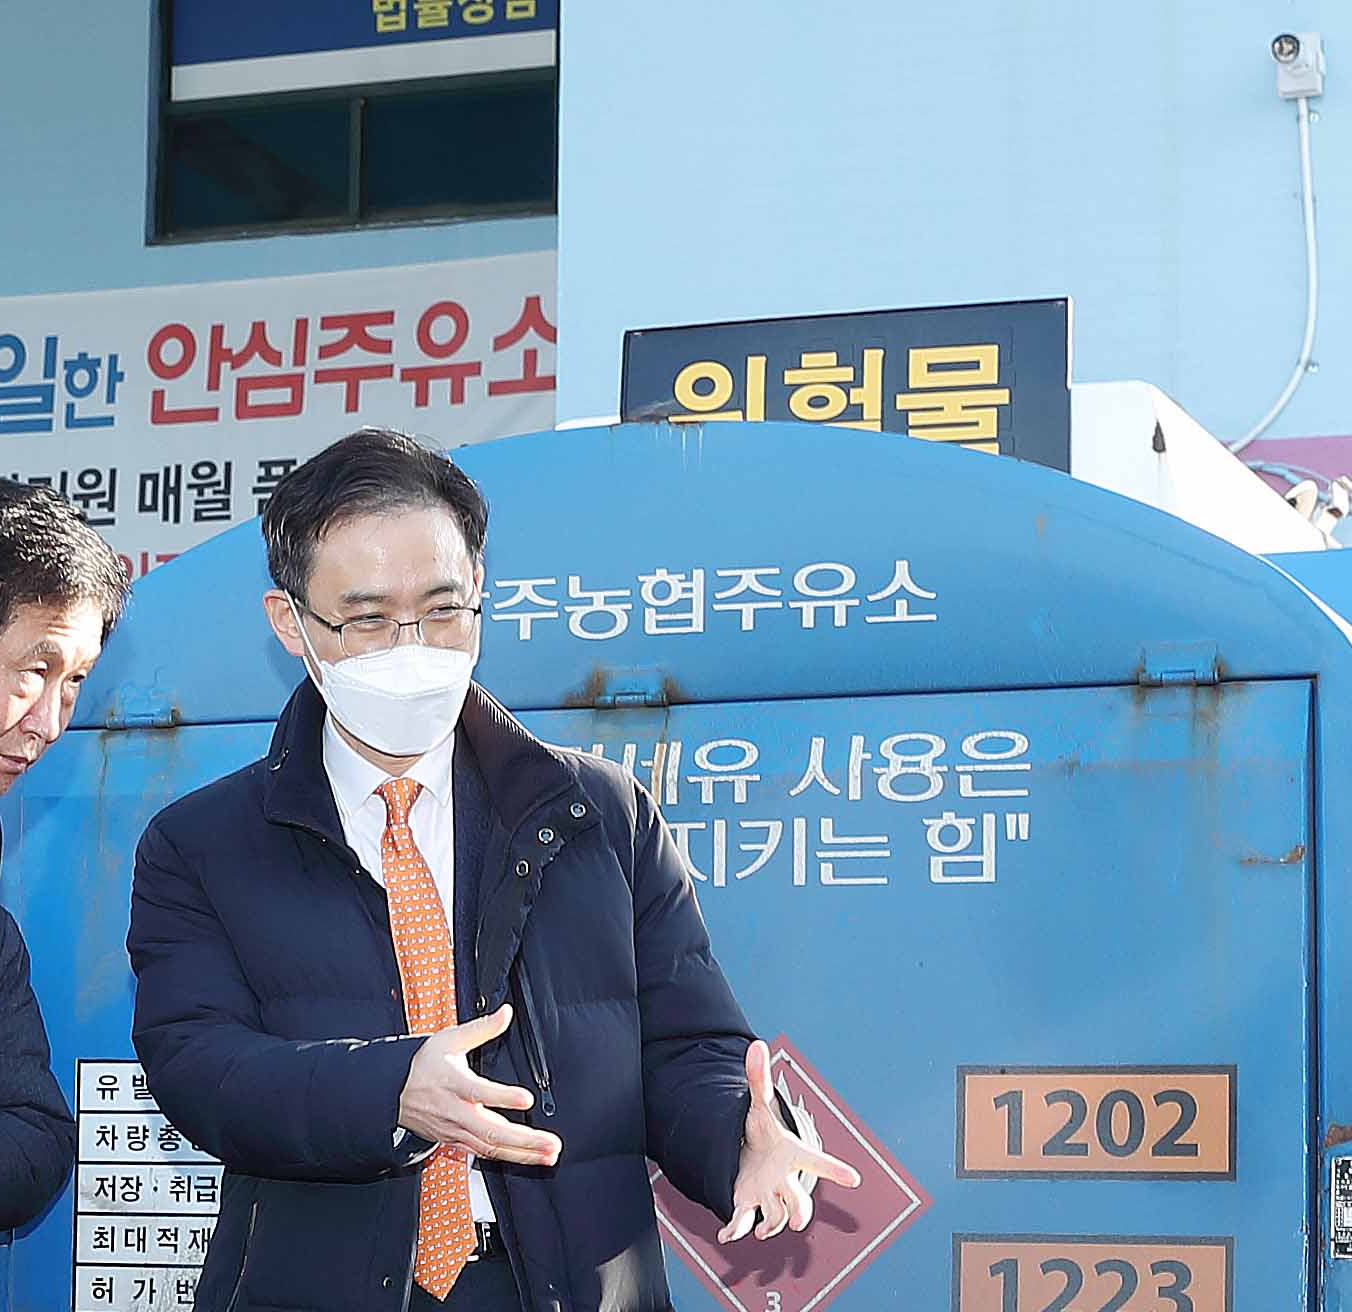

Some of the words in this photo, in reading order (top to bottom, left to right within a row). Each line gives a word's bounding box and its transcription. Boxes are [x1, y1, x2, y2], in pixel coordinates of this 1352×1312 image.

[147, 295, 556, 425] 안심주유소
[138, 460, 232, 524] 매월
[483, 559, 938, 641] 주농협주유소
[570, 738, 761, 805] 세유
[789, 730, 1032, 803] 사용은
[670, 816, 892, 887] 지키는
[95, 1124, 204, 1152] 차량총
[993, 1089, 1199, 1158] 1202
